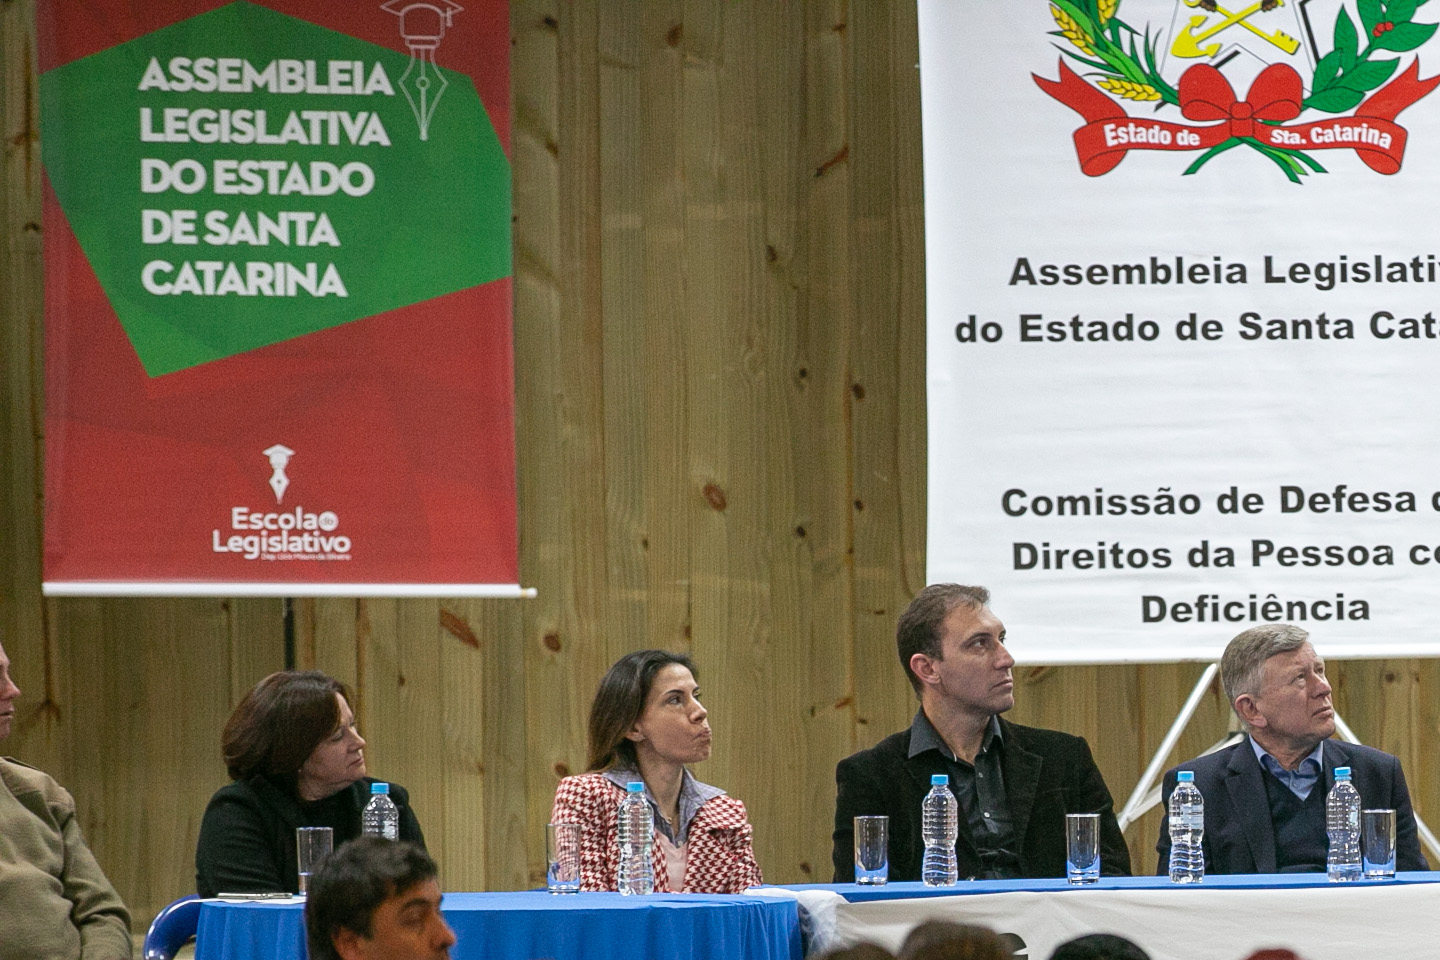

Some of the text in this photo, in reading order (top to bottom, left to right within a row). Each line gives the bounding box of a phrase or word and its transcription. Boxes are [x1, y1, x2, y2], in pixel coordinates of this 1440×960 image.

[139, 58, 396, 97] ASSEMBLEIA
[140, 108, 392, 148] LEGISLATIVA
[1103, 122, 1393, 150] Estado de Sta. Catarina
[141, 159, 376, 198] DO ESTADO
[141, 210, 342, 248] DE SANTA
[141, 260, 349, 299] CATARINA
[1009, 257, 1249, 287] Assembleia
[955, 315, 1004, 344] do
[1020, 314, 1161, 344] Estado
[1175, 313, 1225, 342] de
[1239, 313, 1356, 342] Santa
[1002, 488, 1202, 518] Comissão
[1217, 487, 1265, 515] de
[1280, 484, 1418, 515] Defesa
[231, 506, 319, 531] Escola
[212, 529, 352, 560] Legislativo
[1013, 541, 1173, 571] Direitos
[1187, 540, 1237, 569] da
[1252, 539, 1396, 568] Pessoa
[1142, 593, 1372, 624] Deficiência
